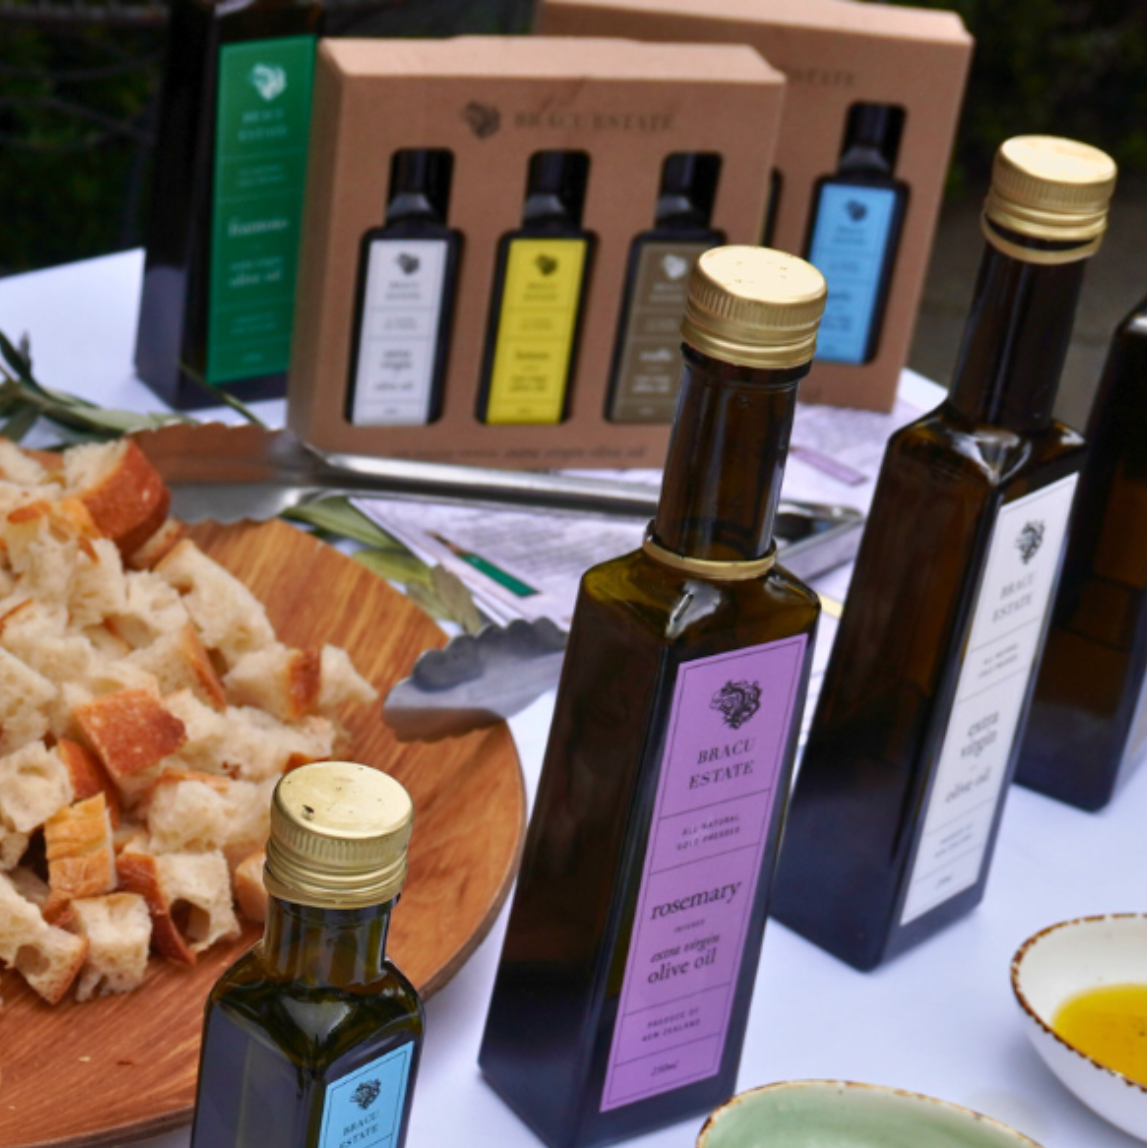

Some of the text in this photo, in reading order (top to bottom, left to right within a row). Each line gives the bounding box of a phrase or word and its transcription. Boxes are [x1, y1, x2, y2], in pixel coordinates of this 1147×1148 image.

[697, 737, 756, 765] BRACU
[688, 760, 755, 790] ESTATE
[650, 881, 743, 921] rosemary
[684, 934, 721, 954] virgin
[647, 949, 717, 985] olive oil
